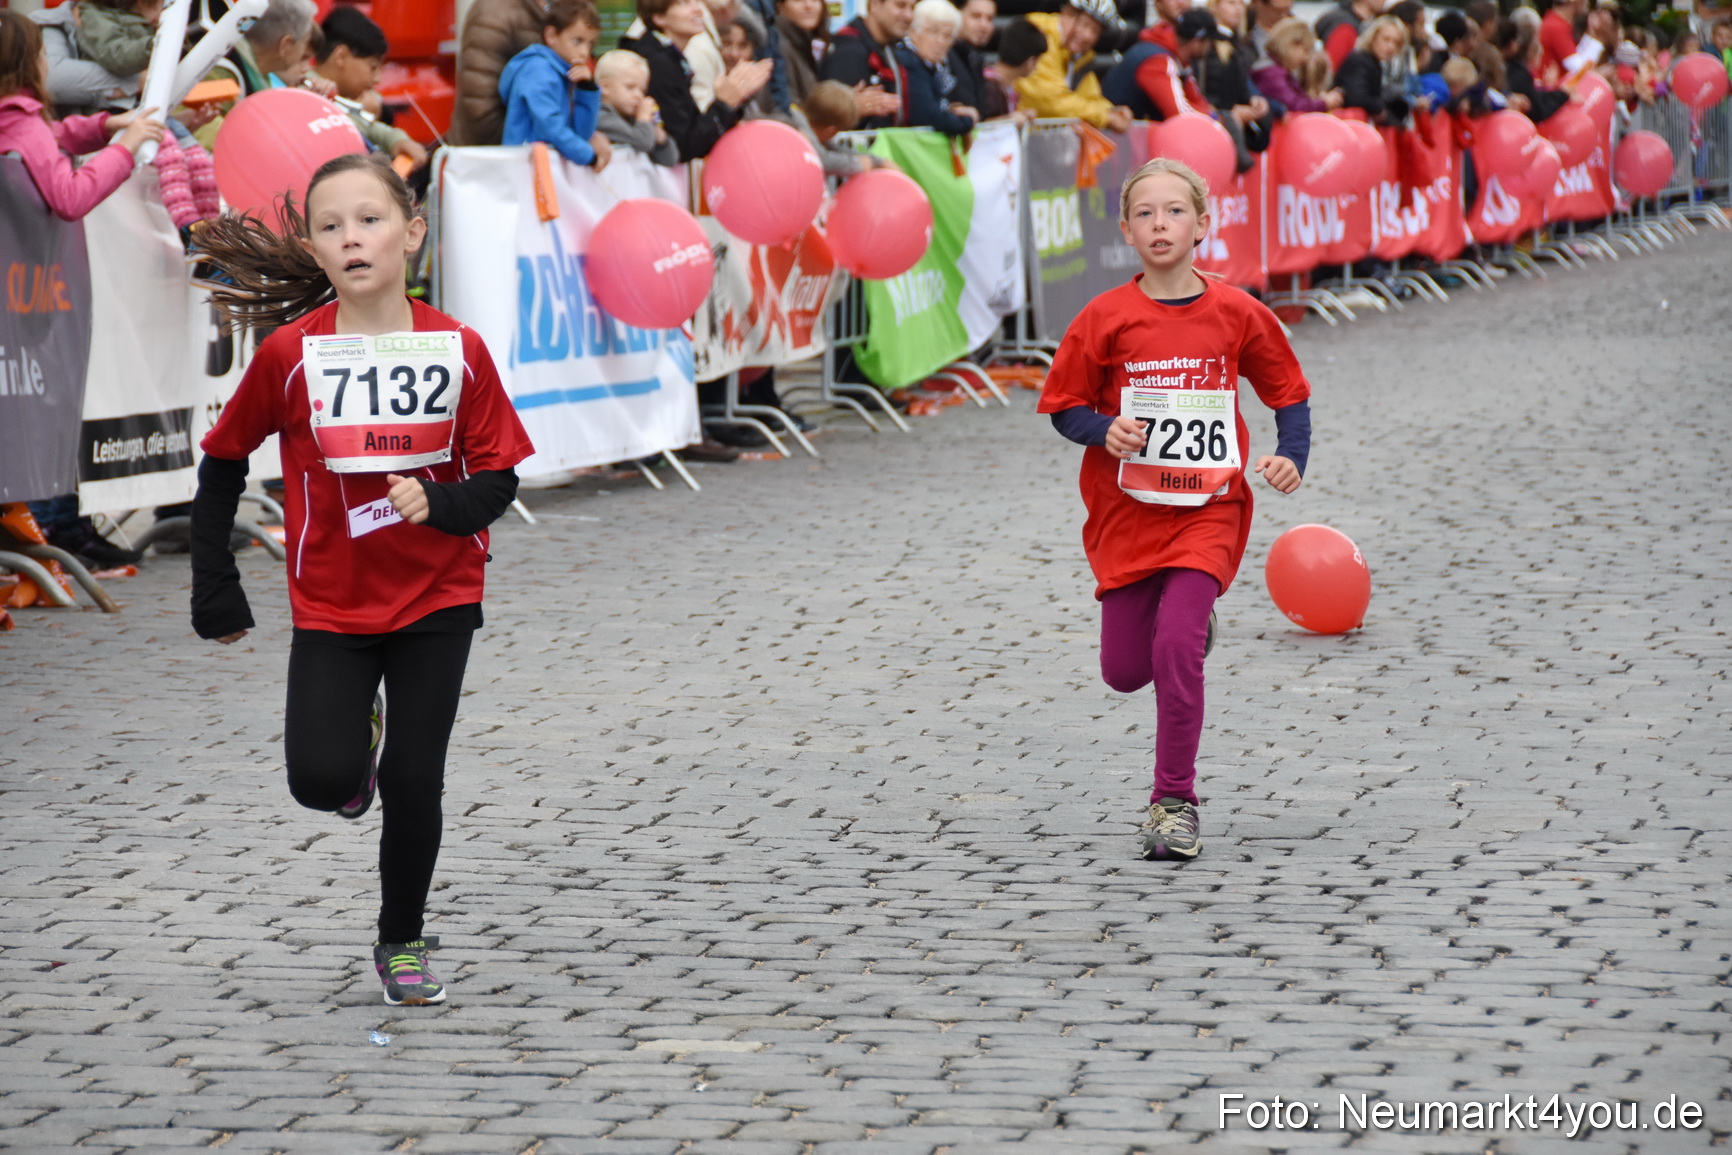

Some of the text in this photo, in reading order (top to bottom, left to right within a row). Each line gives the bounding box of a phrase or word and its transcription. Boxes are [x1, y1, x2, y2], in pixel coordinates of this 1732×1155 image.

[317, 348, 366, 357] NeuerMarkt
[375, 336, 449, 352] BOCK
[1124, 356, 1202, 373] Neumarkter
[322, 364, 451, 418] 7132
[1131, 400, 1170, 409] NeuerMarkt
[1177, 394, 1226, 408] BOCK
[363, 431, 412, 451] Anna
[1135, 416, 1228, 462] 7236
[1160, 471, 1202, 490] Heidi
